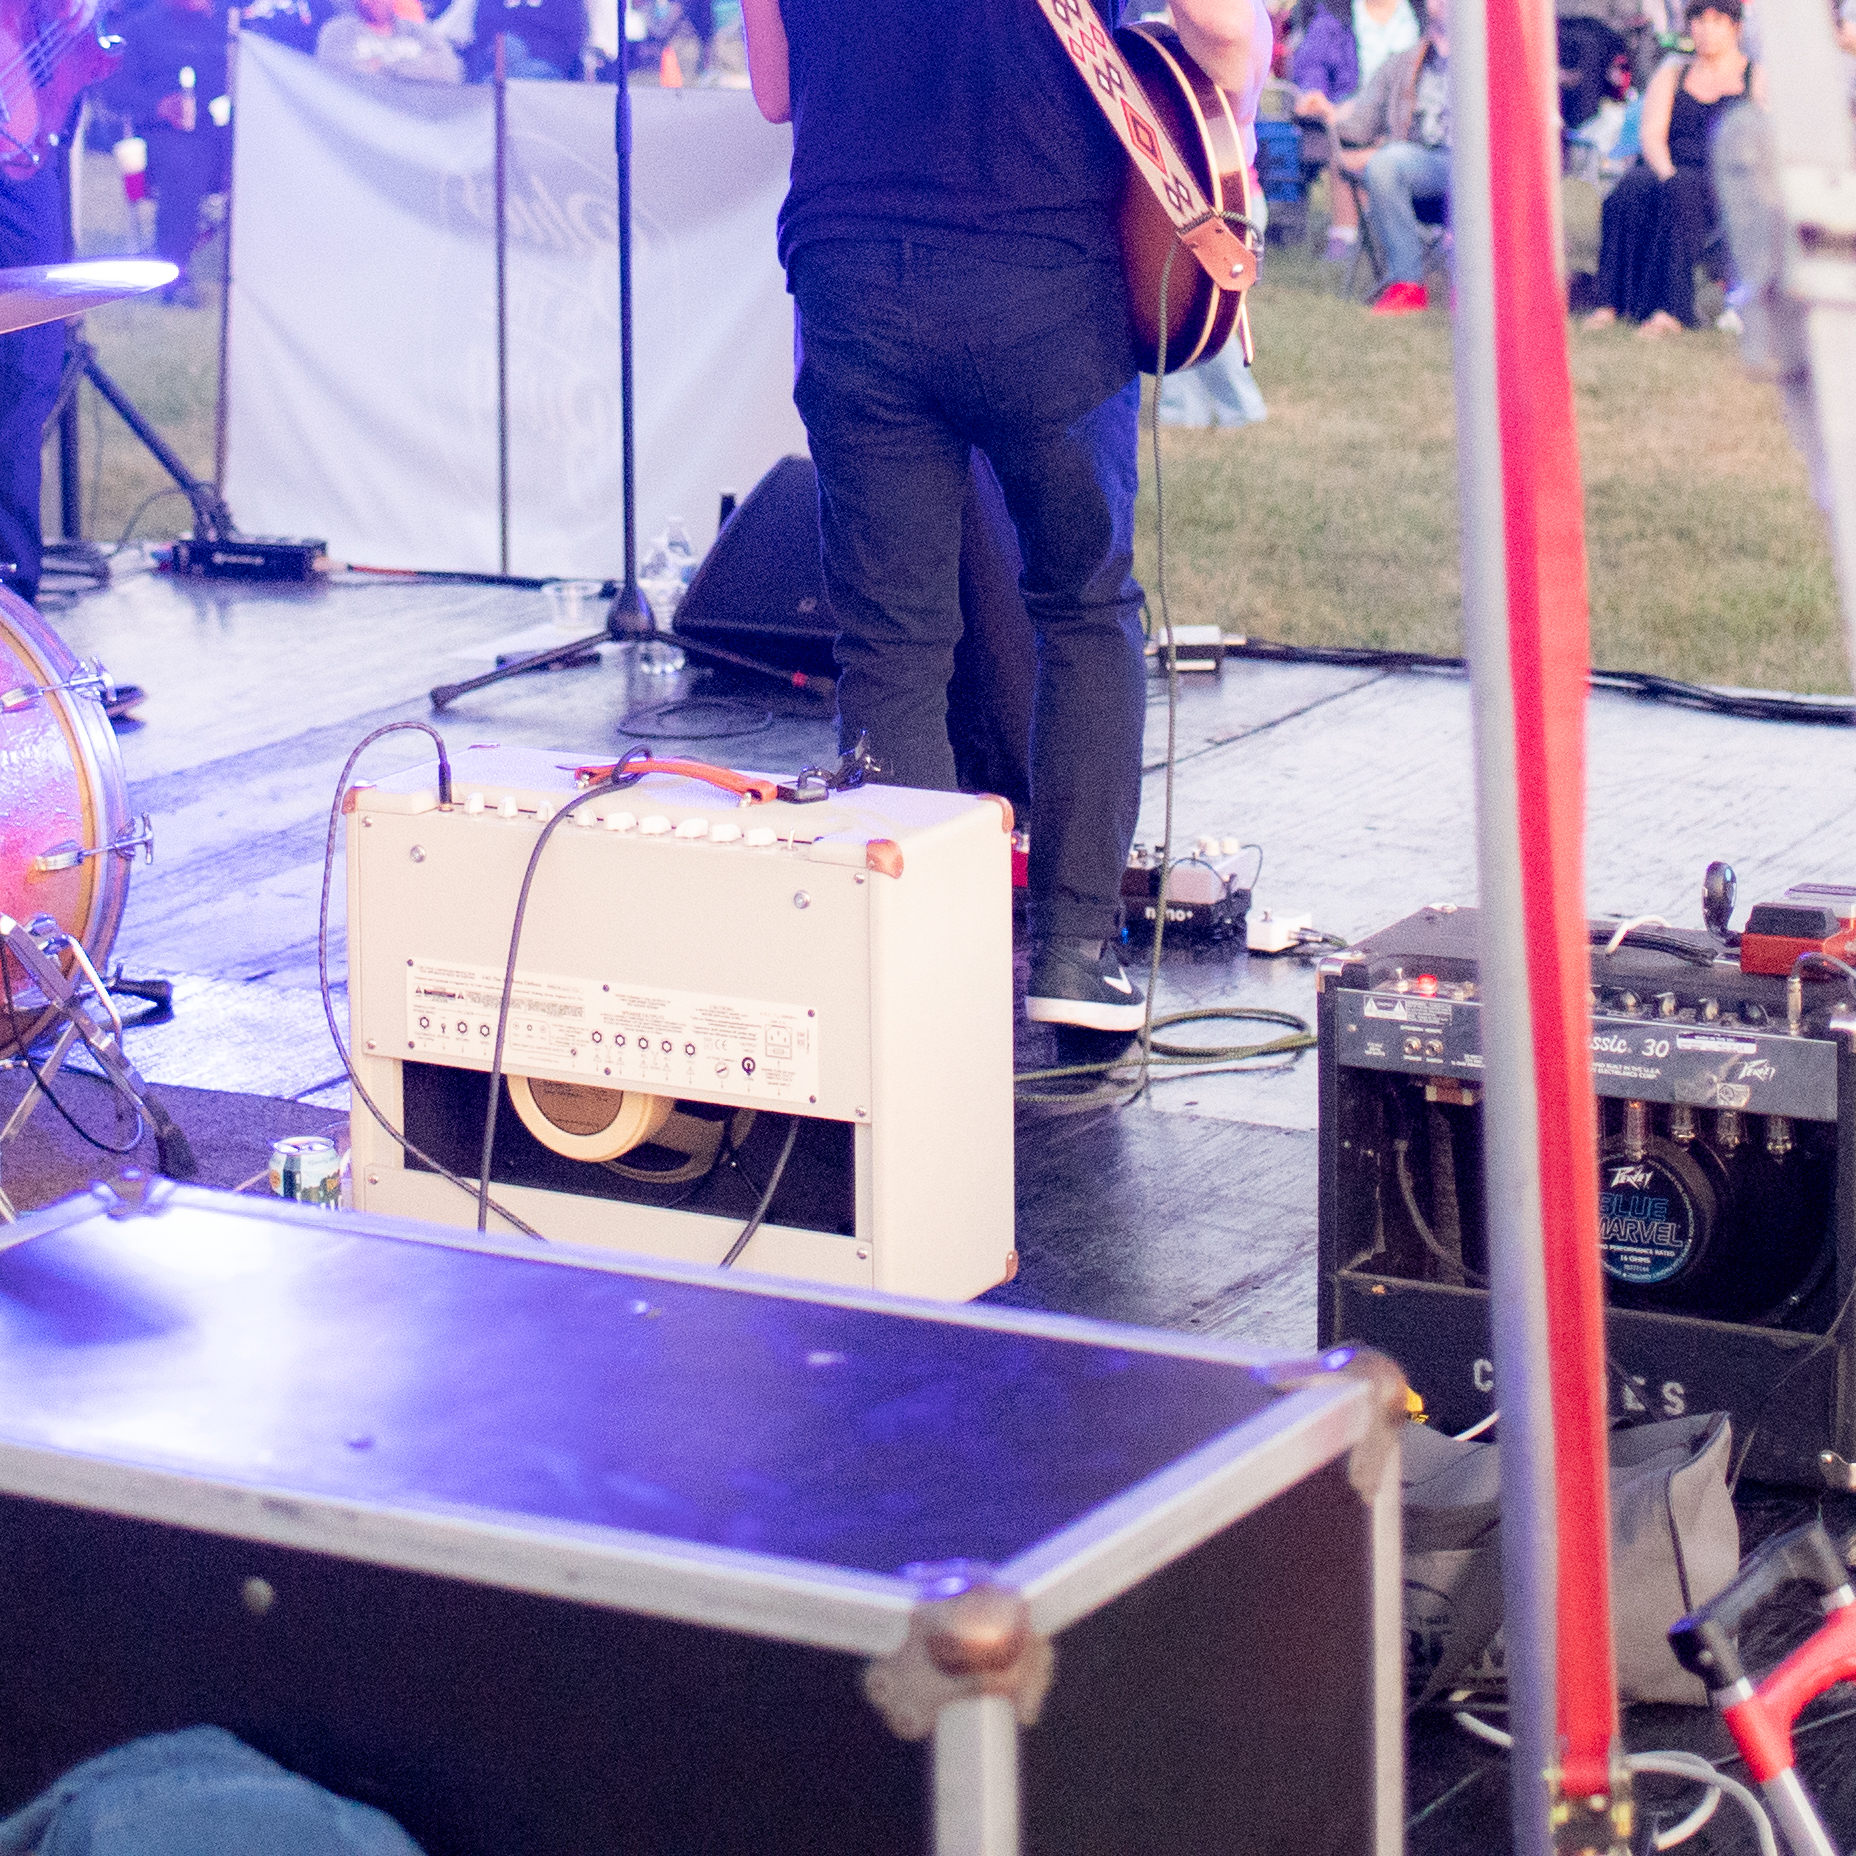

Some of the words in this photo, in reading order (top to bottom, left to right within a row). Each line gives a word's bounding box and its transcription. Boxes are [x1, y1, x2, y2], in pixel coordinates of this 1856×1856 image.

[1145, 906, 1194, 922] nno+
[1641, 1038, 1670, 1058] 30
[1599, 1191, 1669, 1221] BLUE
[1629, 1255, 1651, 1263] OHMS
[1654, 1249, 1676, 1257] RATED
